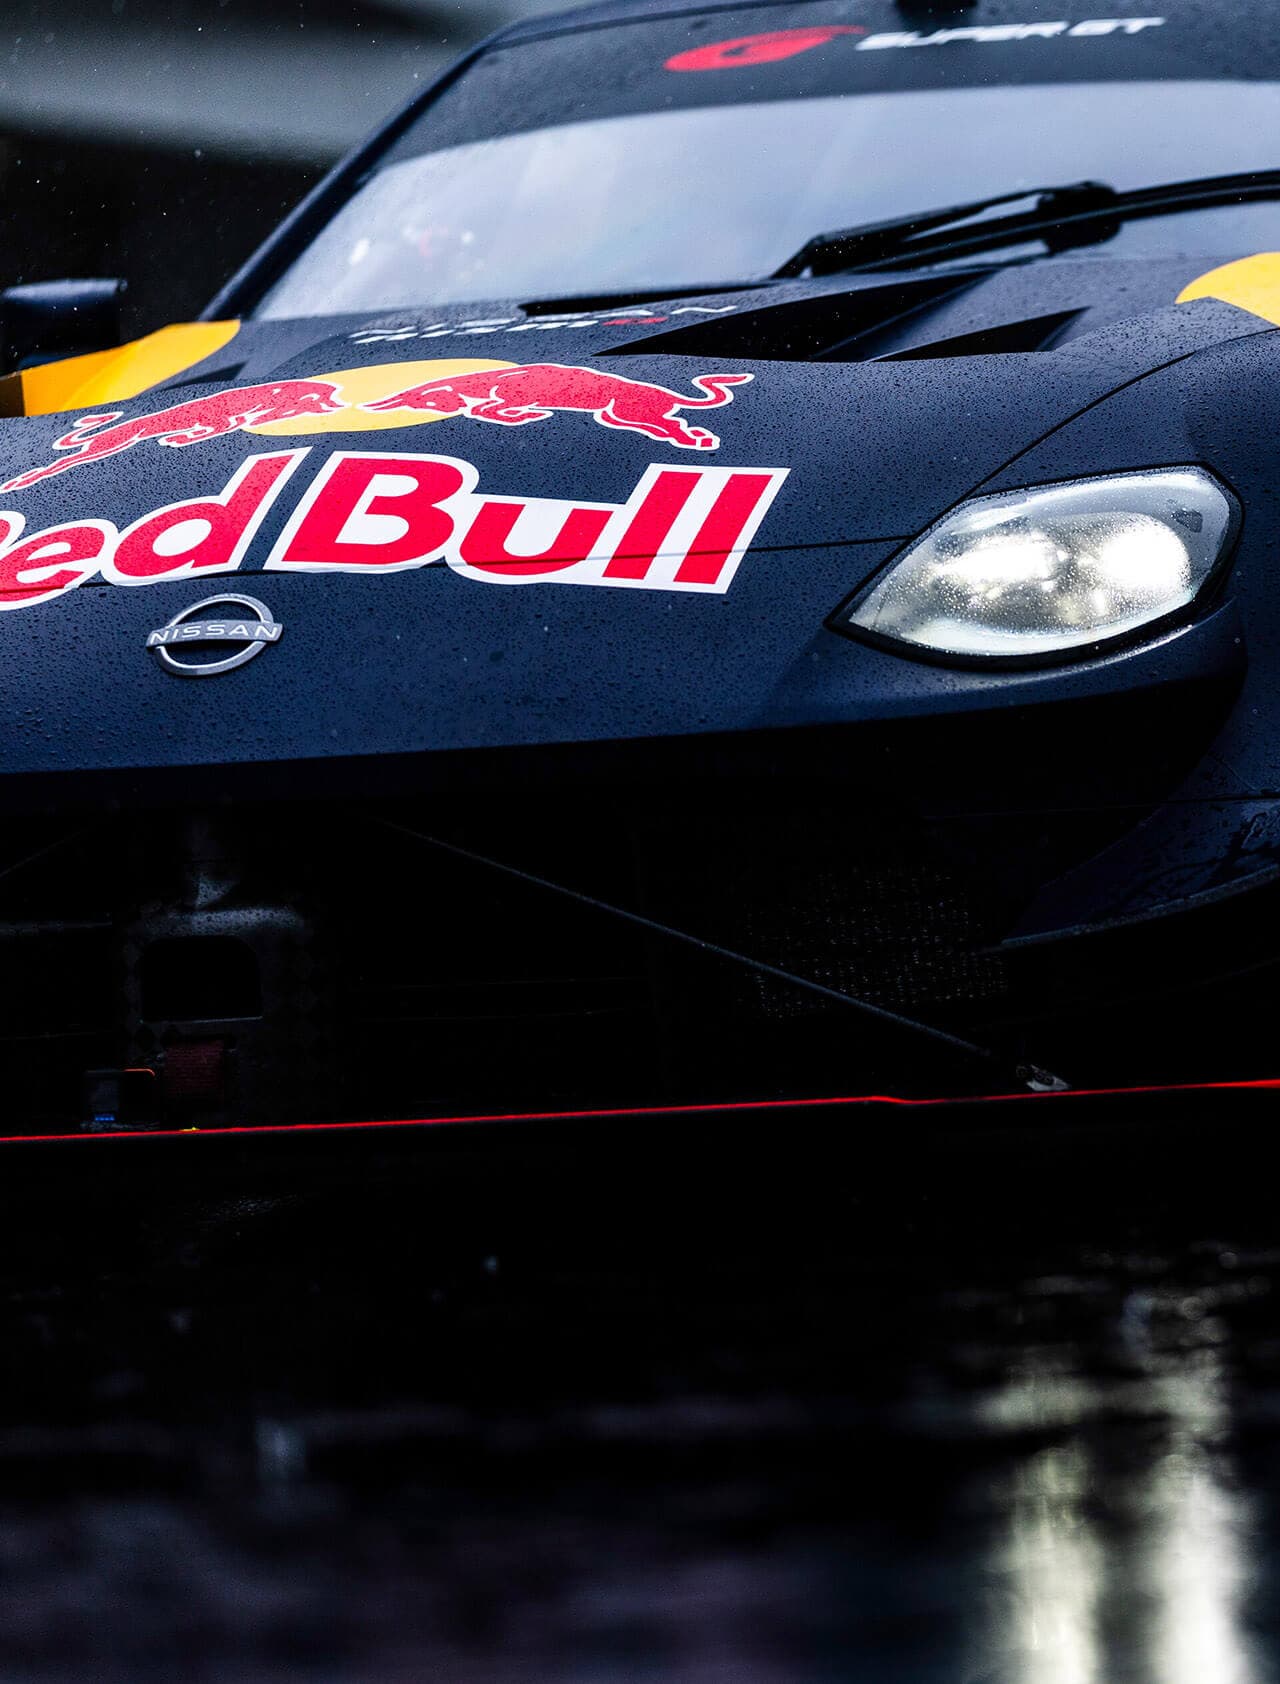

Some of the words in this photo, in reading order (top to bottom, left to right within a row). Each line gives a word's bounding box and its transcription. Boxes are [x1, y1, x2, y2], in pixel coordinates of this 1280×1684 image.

[0, 446, 312, 611] ed
[263, 450, 790, 594] Bull
[150, 624, 278, 645] NISSAN
